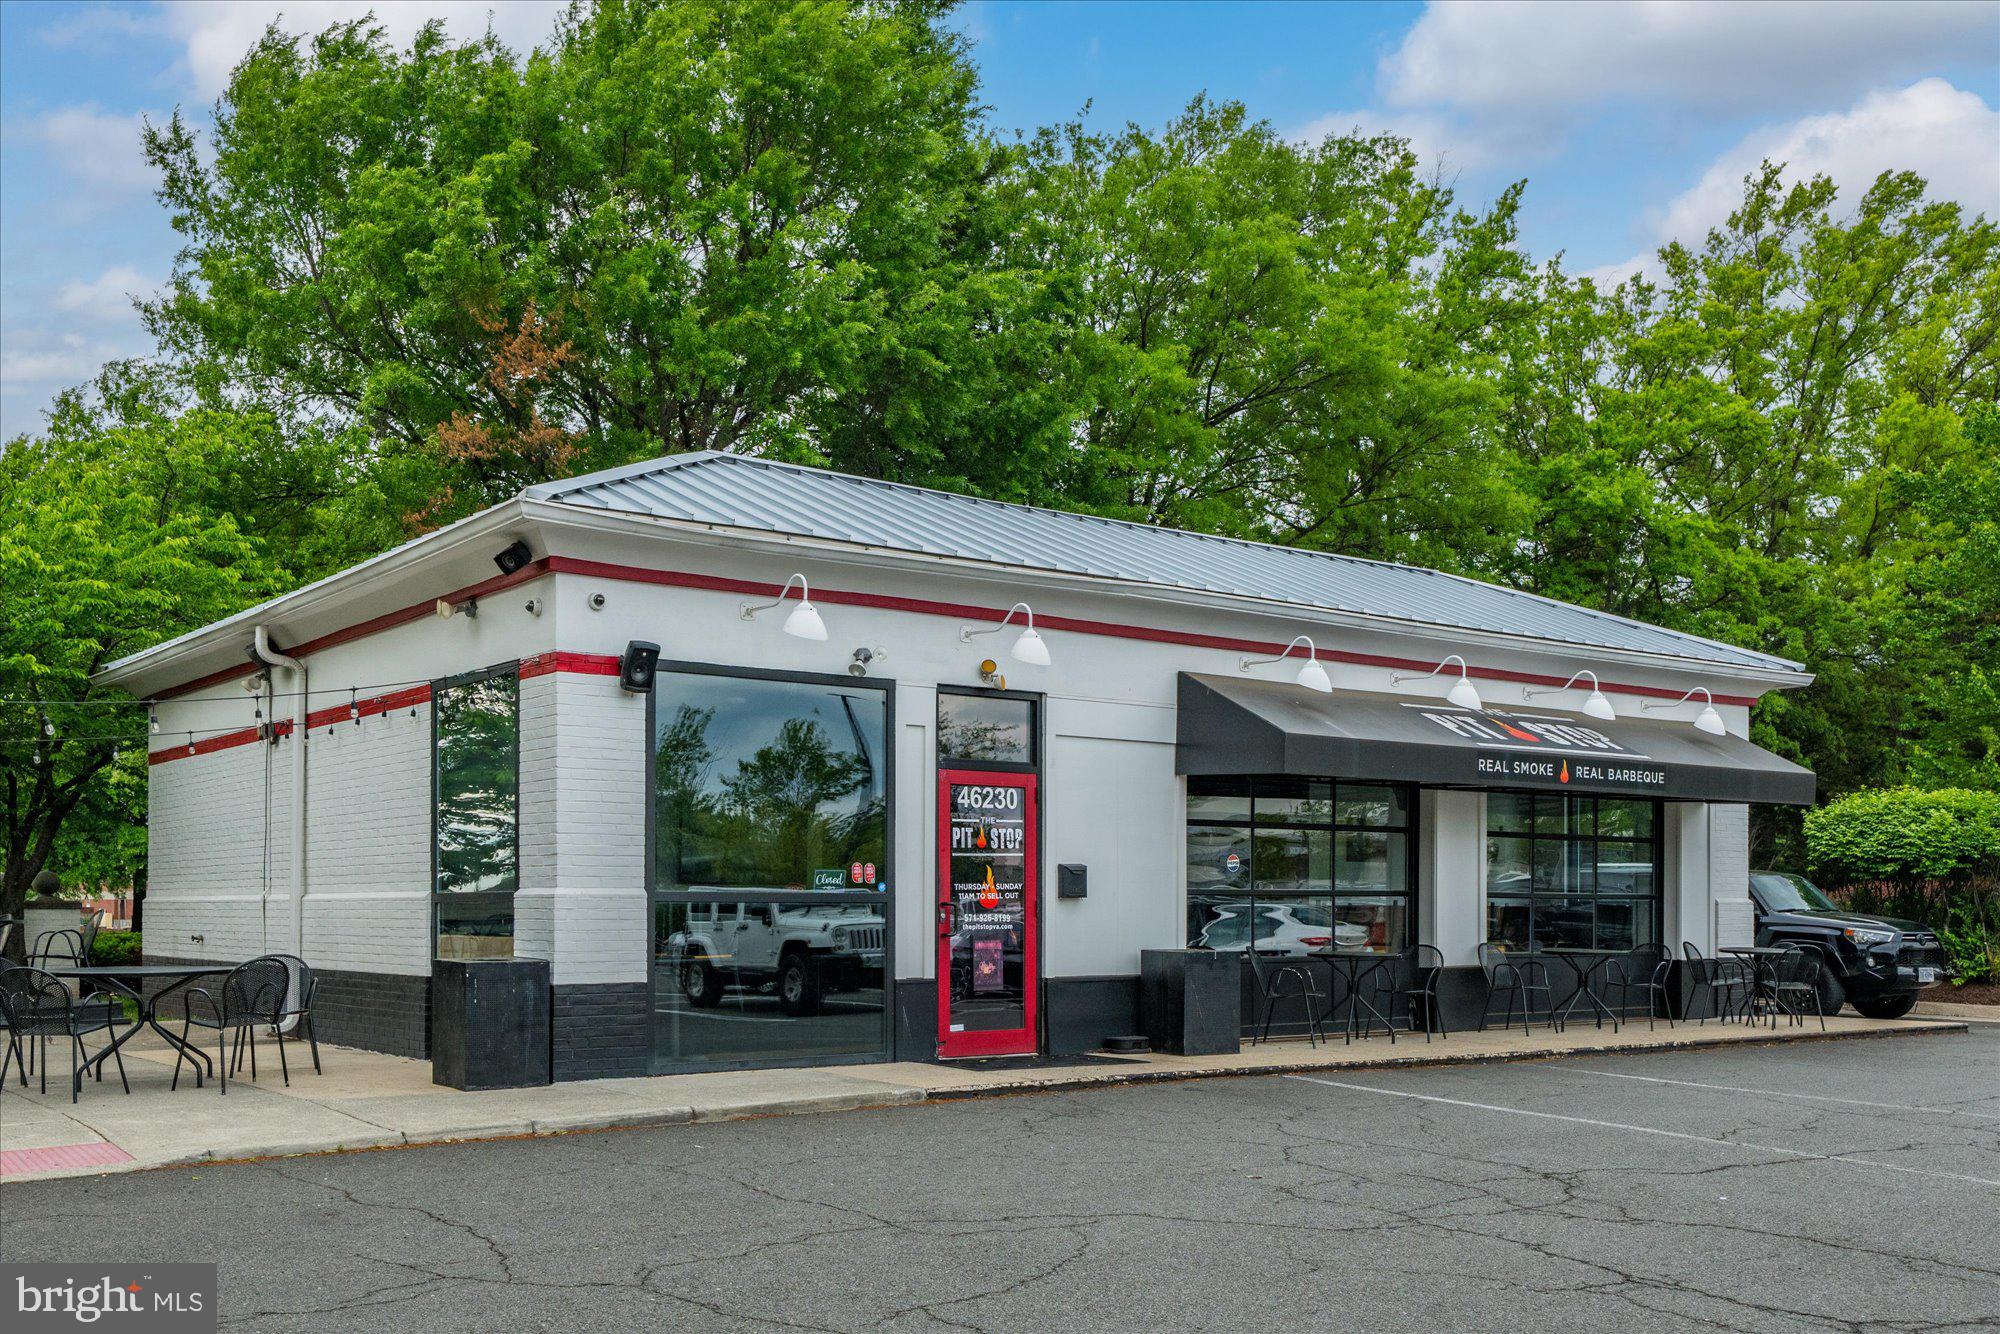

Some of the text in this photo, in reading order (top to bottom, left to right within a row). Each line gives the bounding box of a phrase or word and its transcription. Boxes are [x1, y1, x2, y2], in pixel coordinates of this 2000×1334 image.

[1420, 712, 1624, 750] PIT STOP
[1478, 759, 1665, 784] REAL SMOKE REAL BARBEQUE
[957, 786, 1018, 810] 46230
[981, 816, 996, 824] THE
[952, 827, 1023, 849] PIT STOP
[816, 873, 844, 885] Closed
[954, 883, 990, 891] THURSDAY
